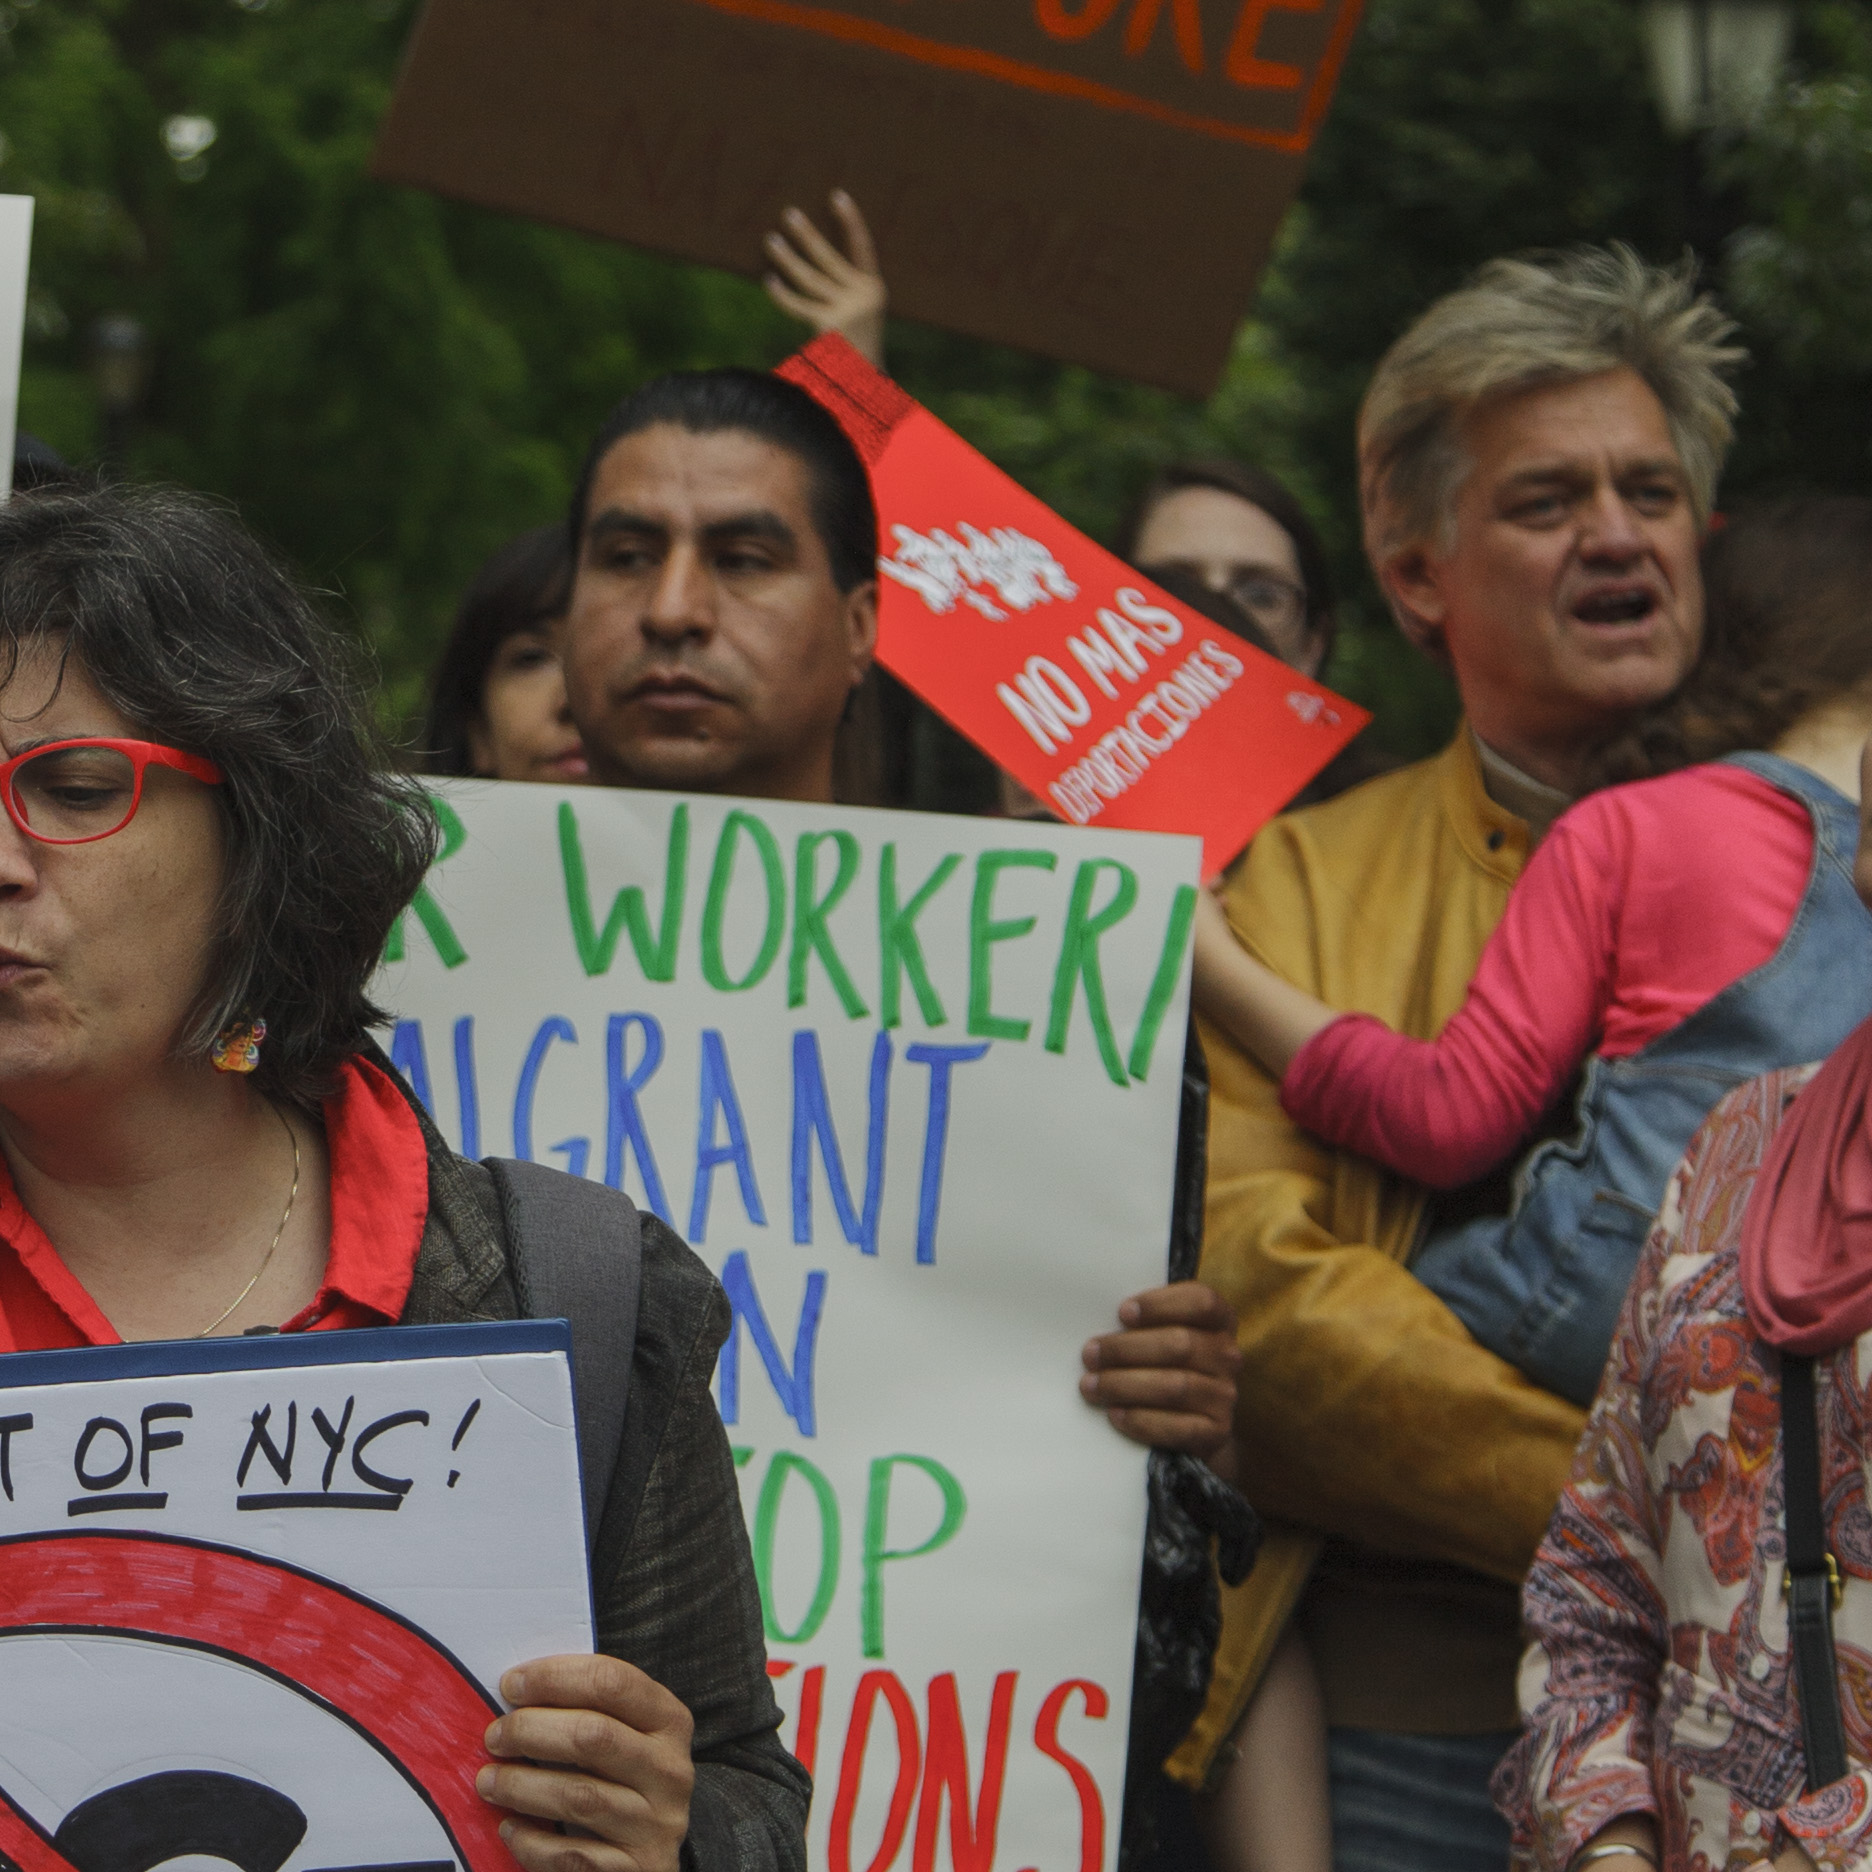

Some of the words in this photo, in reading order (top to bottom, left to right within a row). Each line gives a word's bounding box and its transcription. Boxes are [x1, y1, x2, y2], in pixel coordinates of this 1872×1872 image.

[996, 655, 1091, 757] NO
[1065, 587, 1184, 701] MAS
[1047, 638, 1244, 825] DEPORTACIONES
[74, 1402, 193, 1490] OF
[236, 1395, 482, 1493] NYC!
